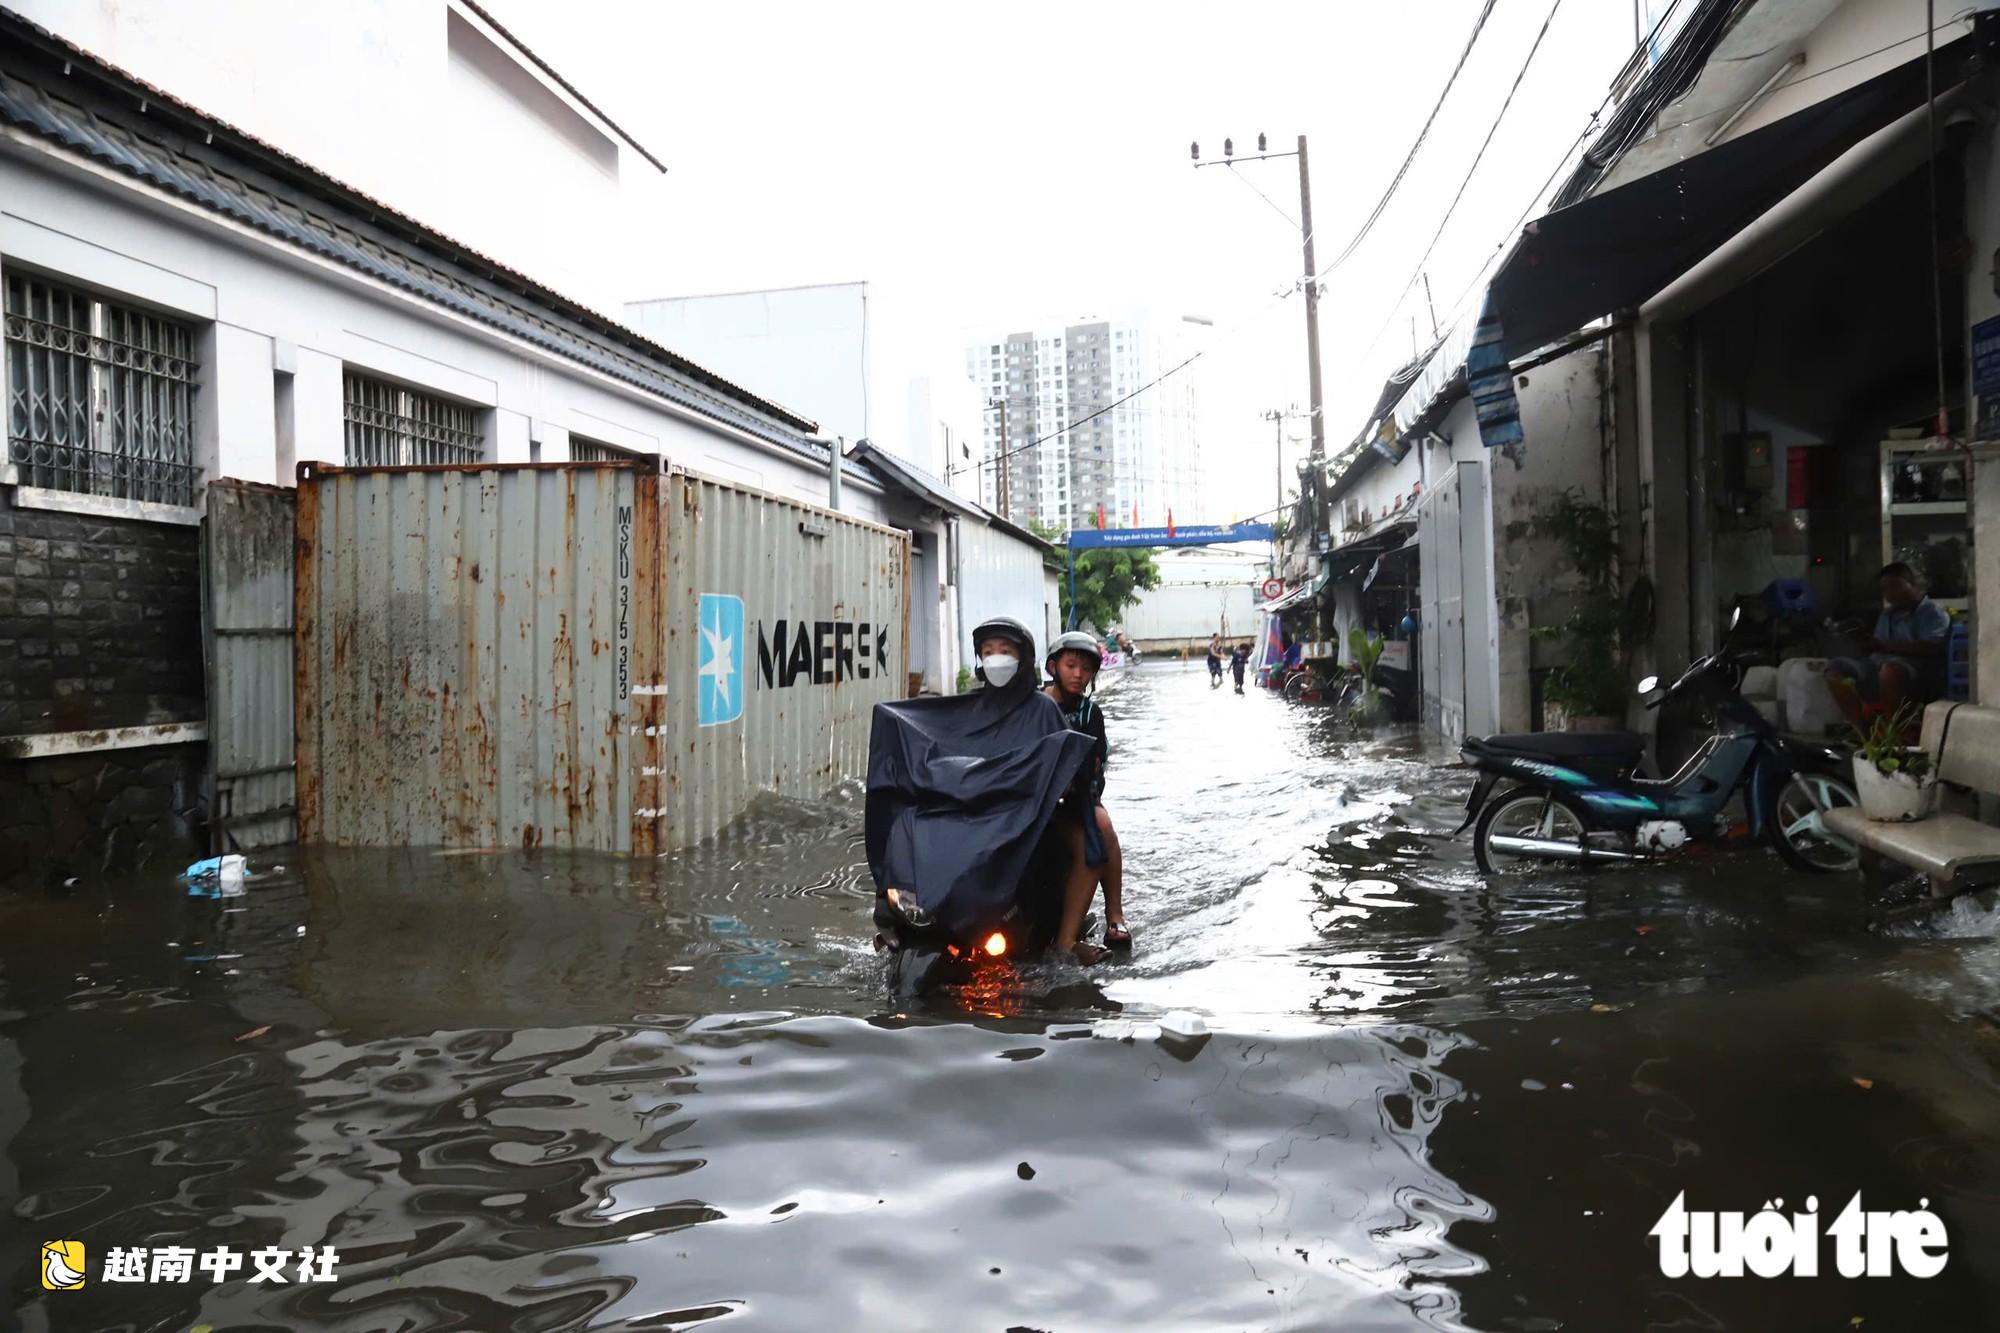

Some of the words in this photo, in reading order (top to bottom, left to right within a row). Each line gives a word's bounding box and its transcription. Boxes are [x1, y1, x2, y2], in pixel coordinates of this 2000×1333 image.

[619, 506, 631, 579] MSKU
[619, 585, 628, 640] 375
[619, 646, 628, 700] 353
[756, 618, 889, 692] MAERSK
